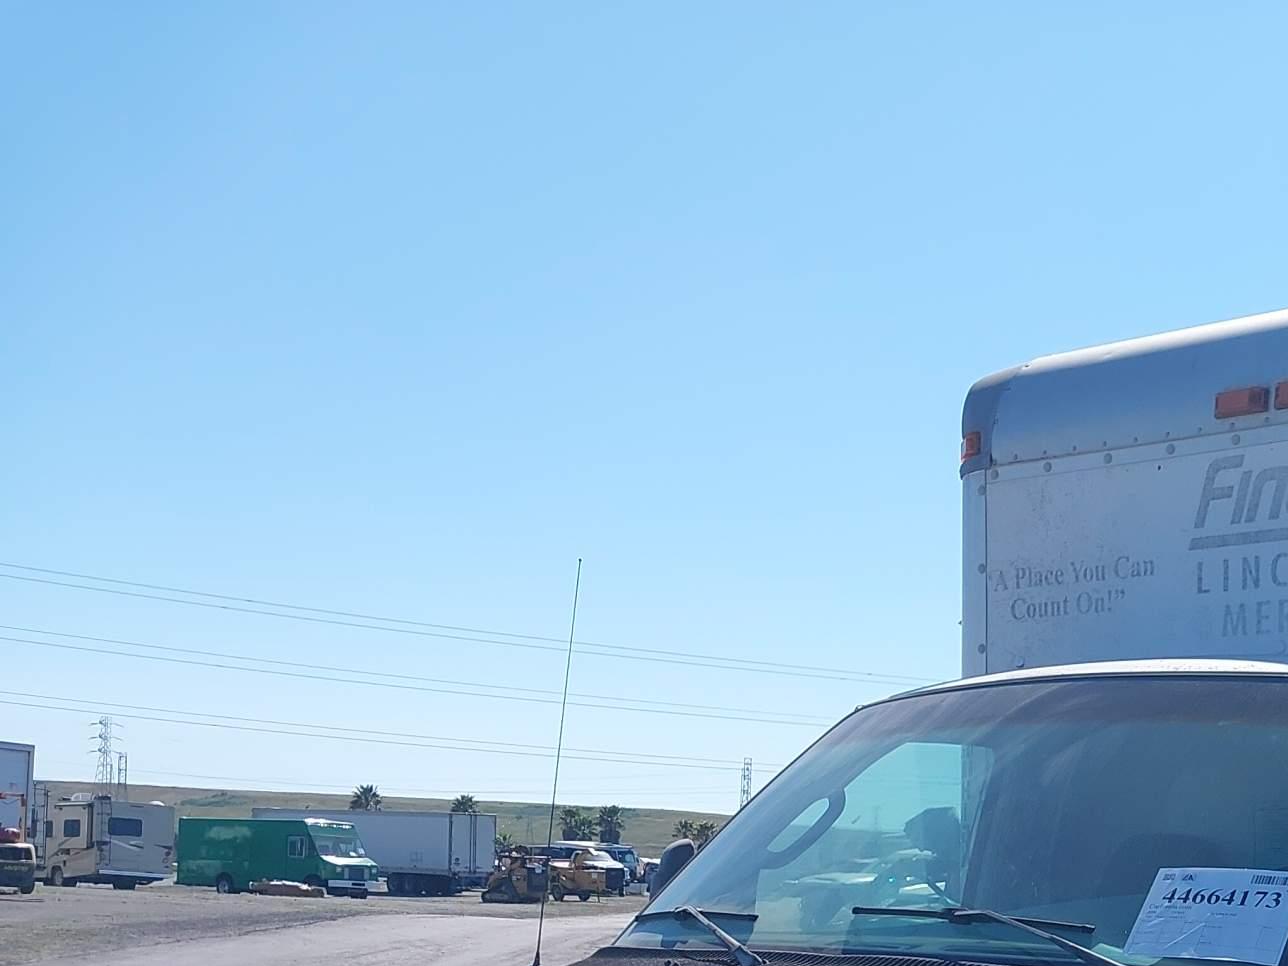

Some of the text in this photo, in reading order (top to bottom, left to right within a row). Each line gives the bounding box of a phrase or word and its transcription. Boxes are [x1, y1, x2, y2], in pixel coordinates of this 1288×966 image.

[1015, 565, 1064, 590] Place
[1070, 560, 1106, 584] You
[1114, 555, 1155, 580] Can
[1010, 596, 1069, 621] Count
[1162, 887, 1282, 909] 44664173
